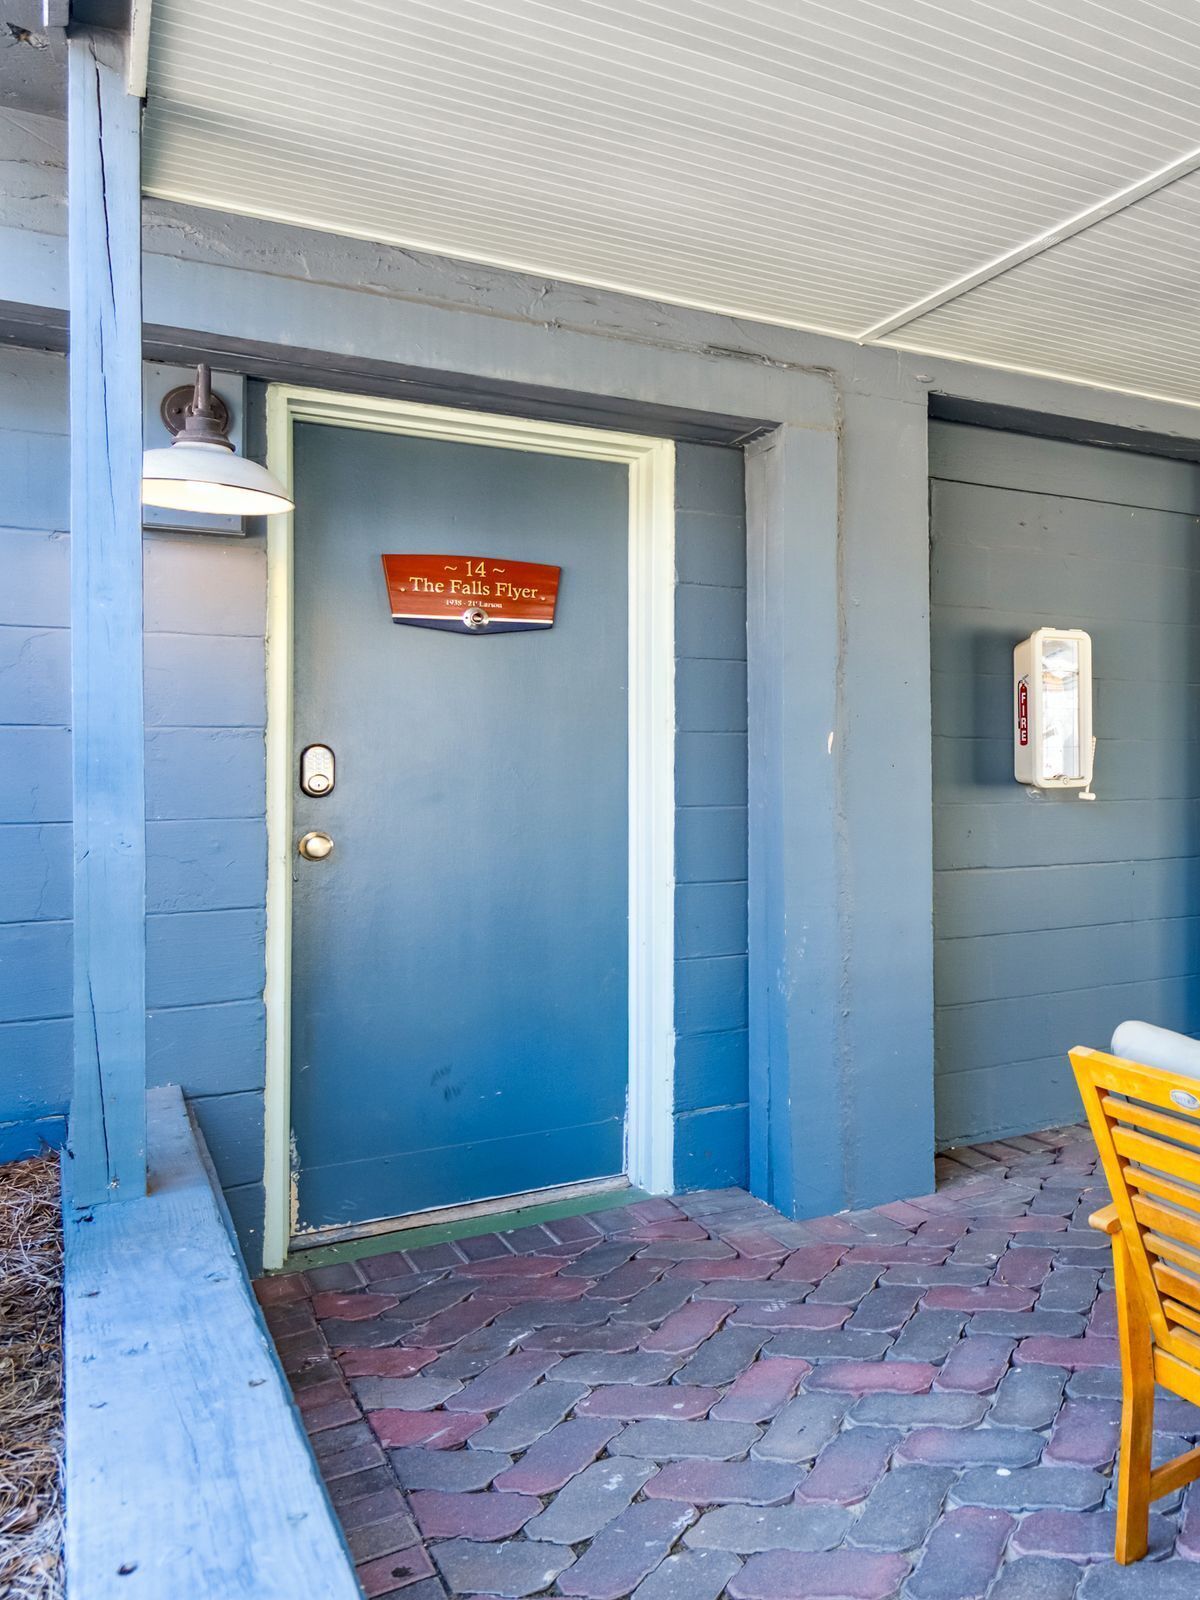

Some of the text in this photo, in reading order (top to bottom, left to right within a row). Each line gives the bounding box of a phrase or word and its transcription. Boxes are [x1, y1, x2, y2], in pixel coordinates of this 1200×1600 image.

[466, 561, 486, 577] 14
[409, 577, 538, 600] The Falls Flyer
